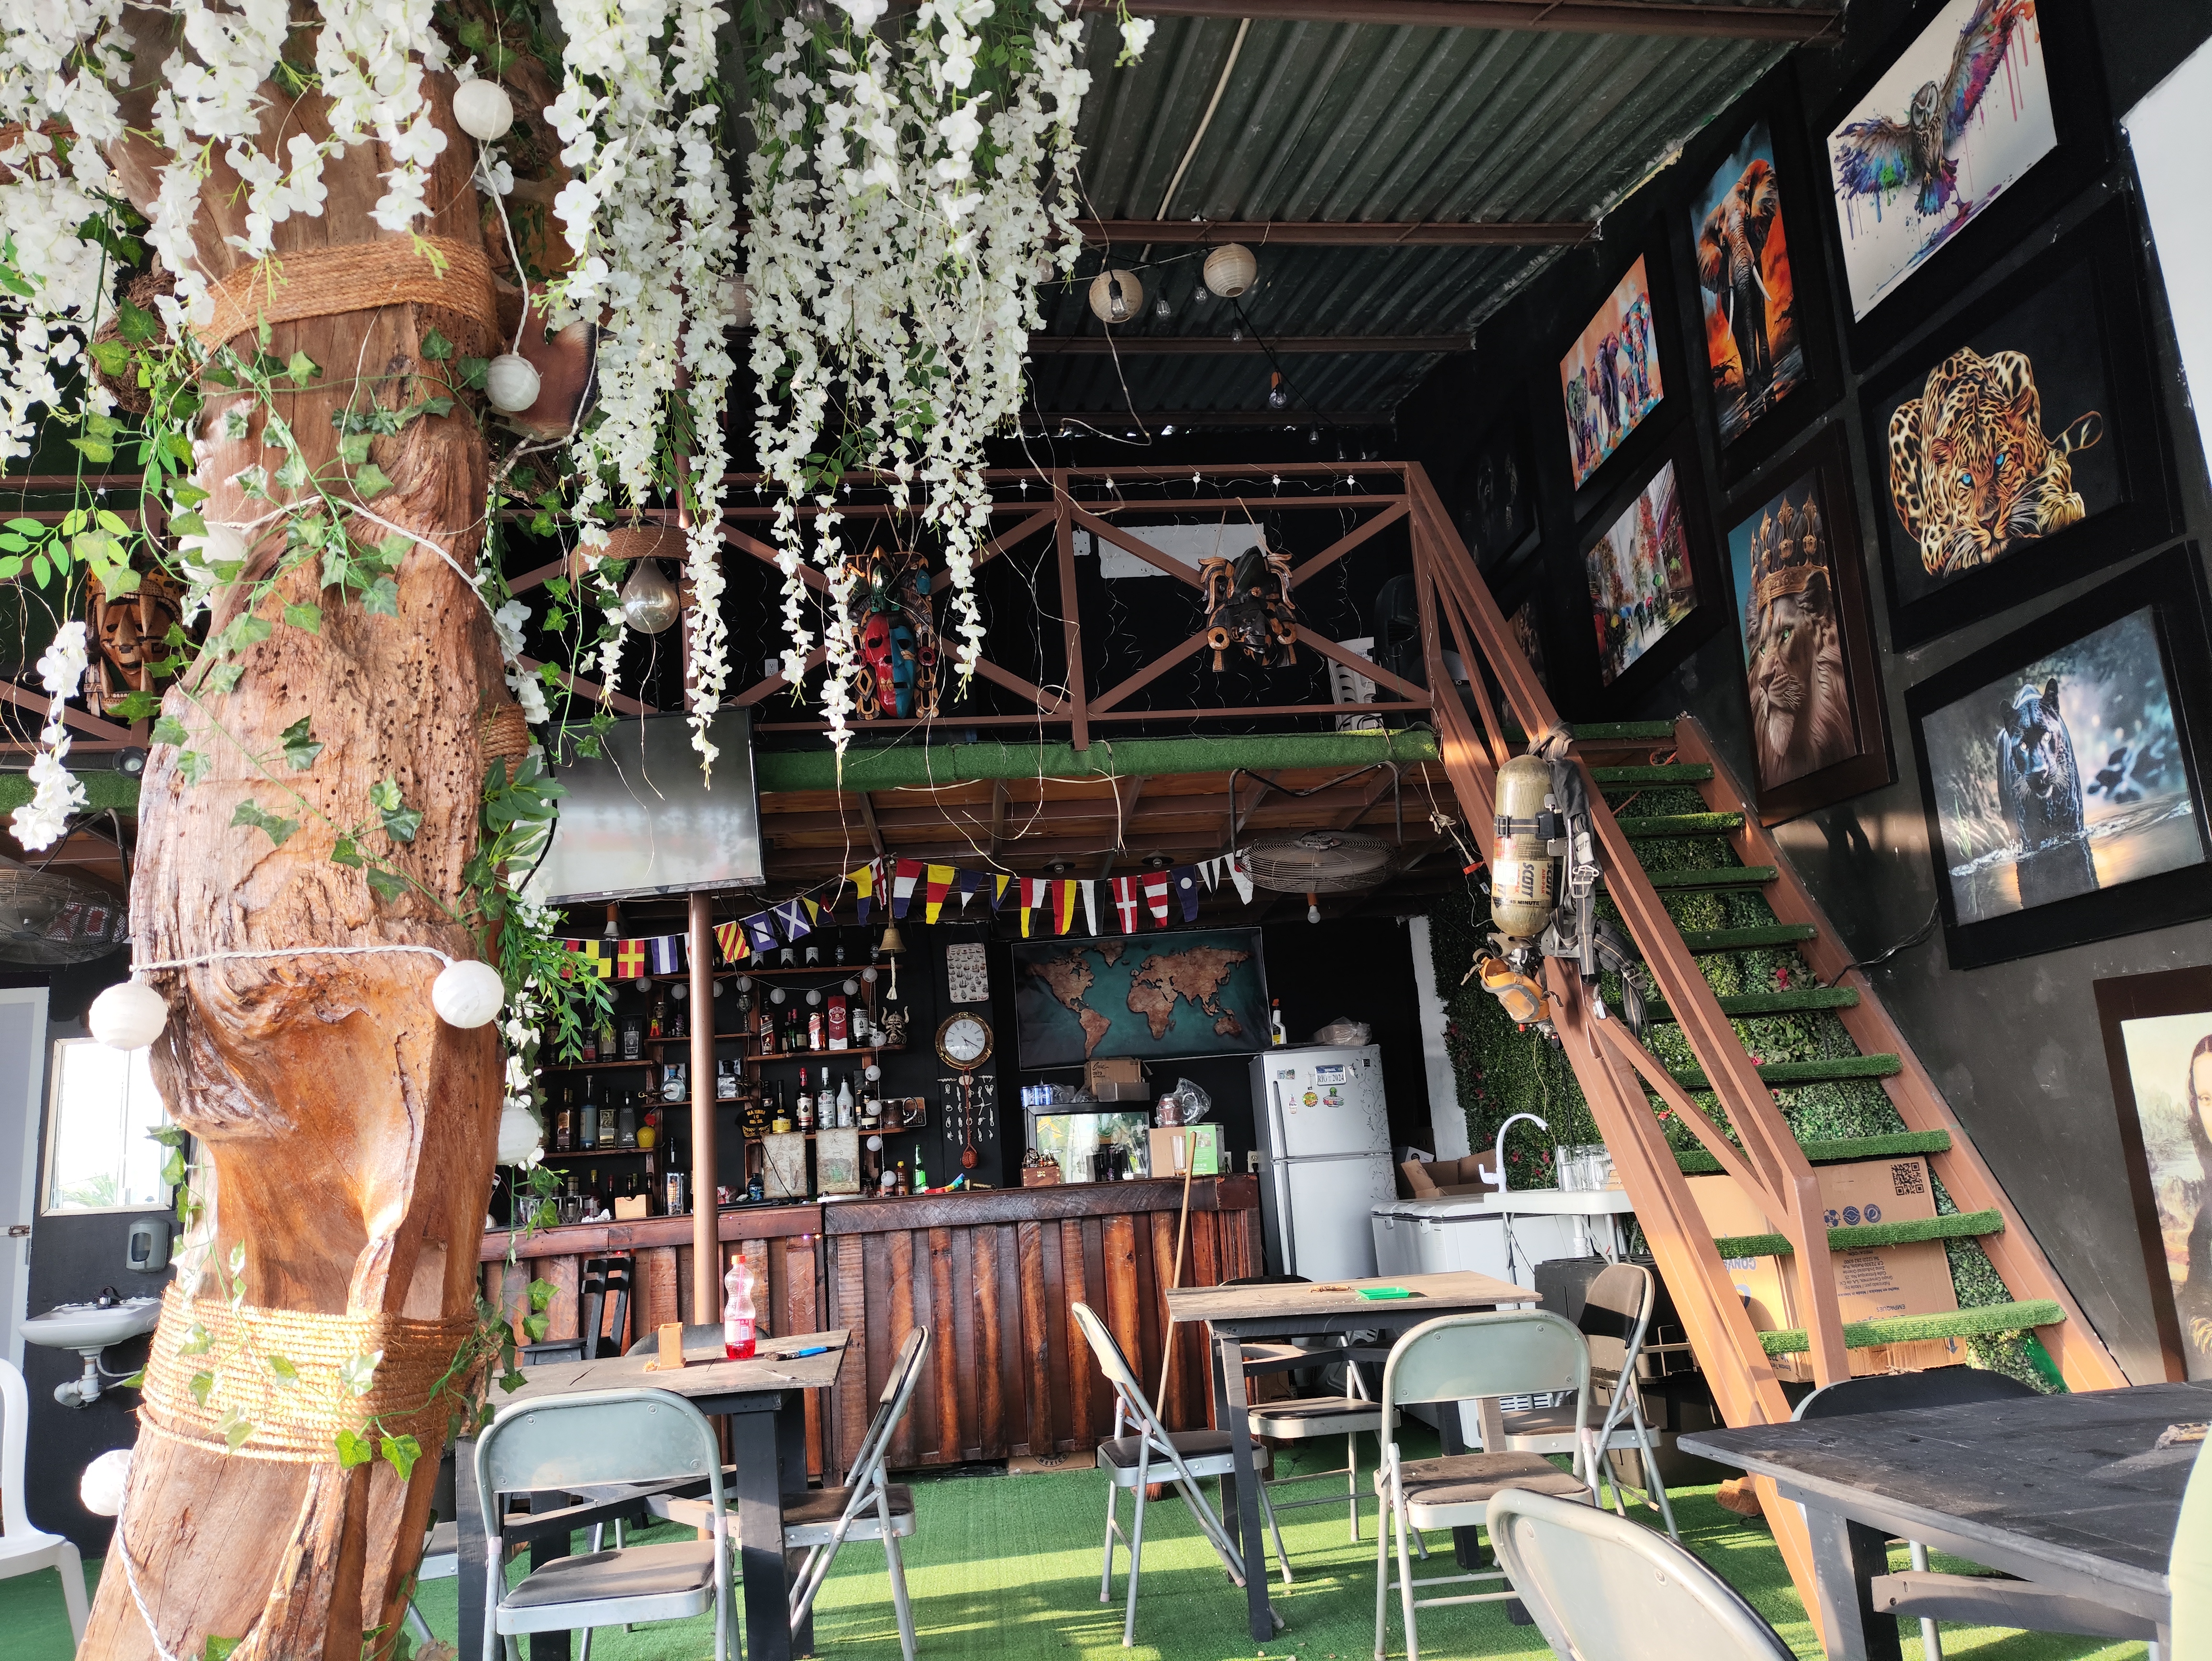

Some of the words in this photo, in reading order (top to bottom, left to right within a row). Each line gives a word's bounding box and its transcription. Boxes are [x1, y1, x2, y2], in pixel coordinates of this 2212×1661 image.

[1521, 862, 1534, 898] SCOTT
[1876, 1304, 1905, 1312] EMPAQUES
[1039, 1454, 1067, 1465] MEXICO
